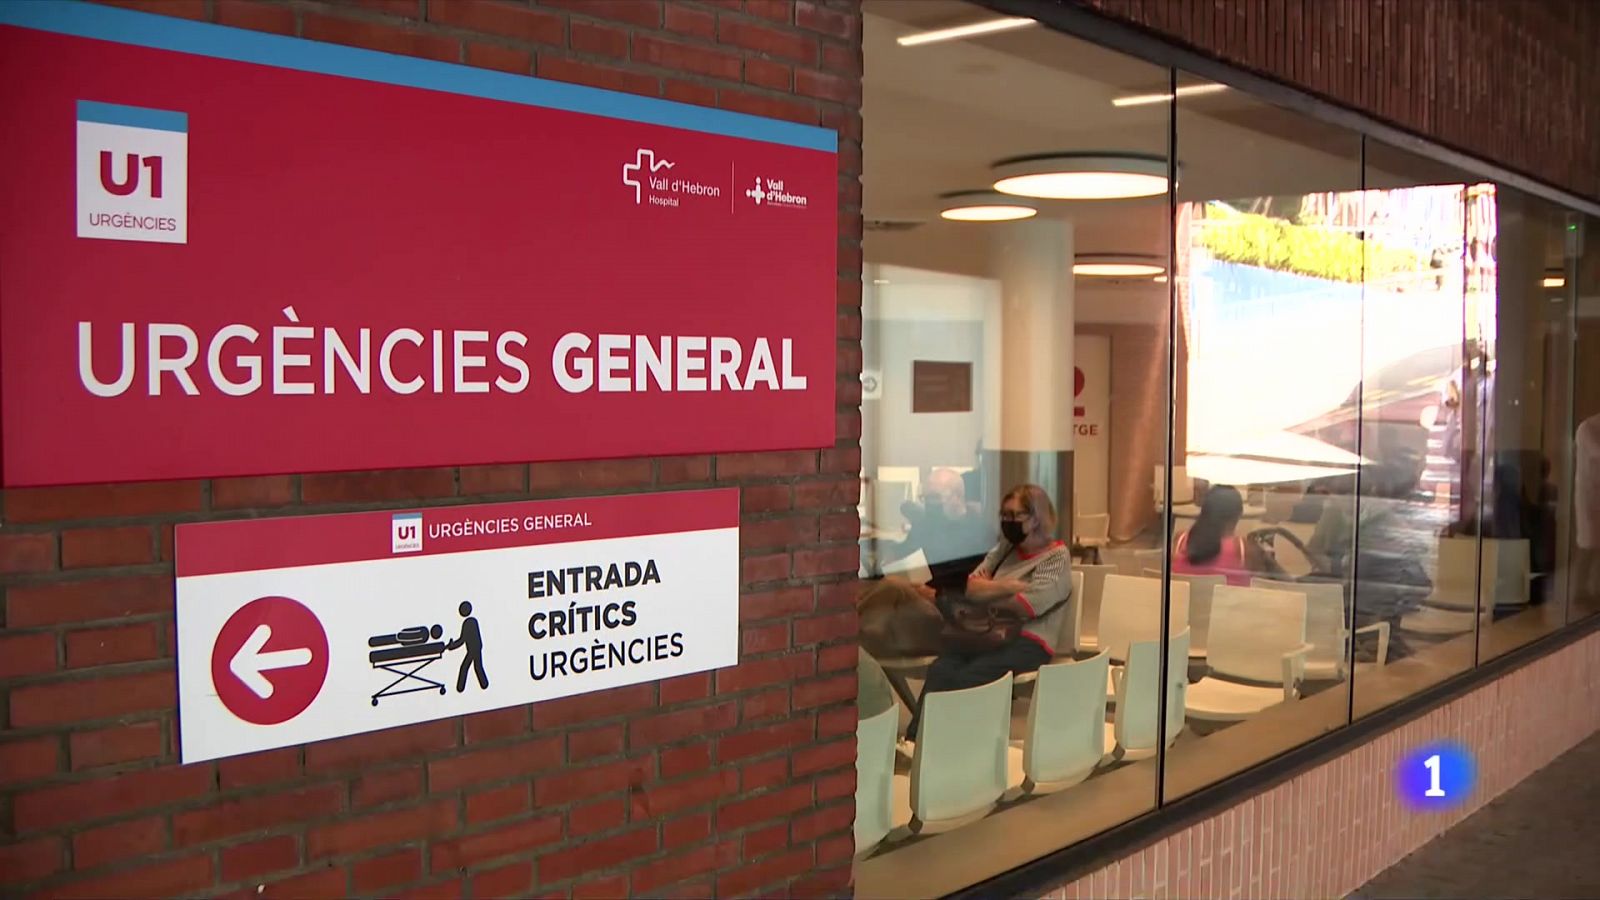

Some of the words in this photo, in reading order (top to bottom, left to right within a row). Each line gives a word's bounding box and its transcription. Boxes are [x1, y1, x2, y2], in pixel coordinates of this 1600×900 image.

[100, 150, 162, 198] U1
[649, 176, 669, 191] Vall
[671, 180, 720, 197] d'Hebron
[766, 179, 784, 191] Vall
[649, 195, 679, 207] Hospital
[89, 212, 176, 231] URGÈNCIES
[78, 305, 530, 397] URGÈNCIES
[552, 332, 807, 393] GENERAL
[398, 526, 416, 540] U1
[429, 517, 519, 539] URGÈNCIES
[523, 512, 592, 531] GENERAL
[528, 559, 661, 599] ENTRADA
[528, 601, 637, 639] CRÍTICS
[530, 633, 684, 681] URGÈNCIES
